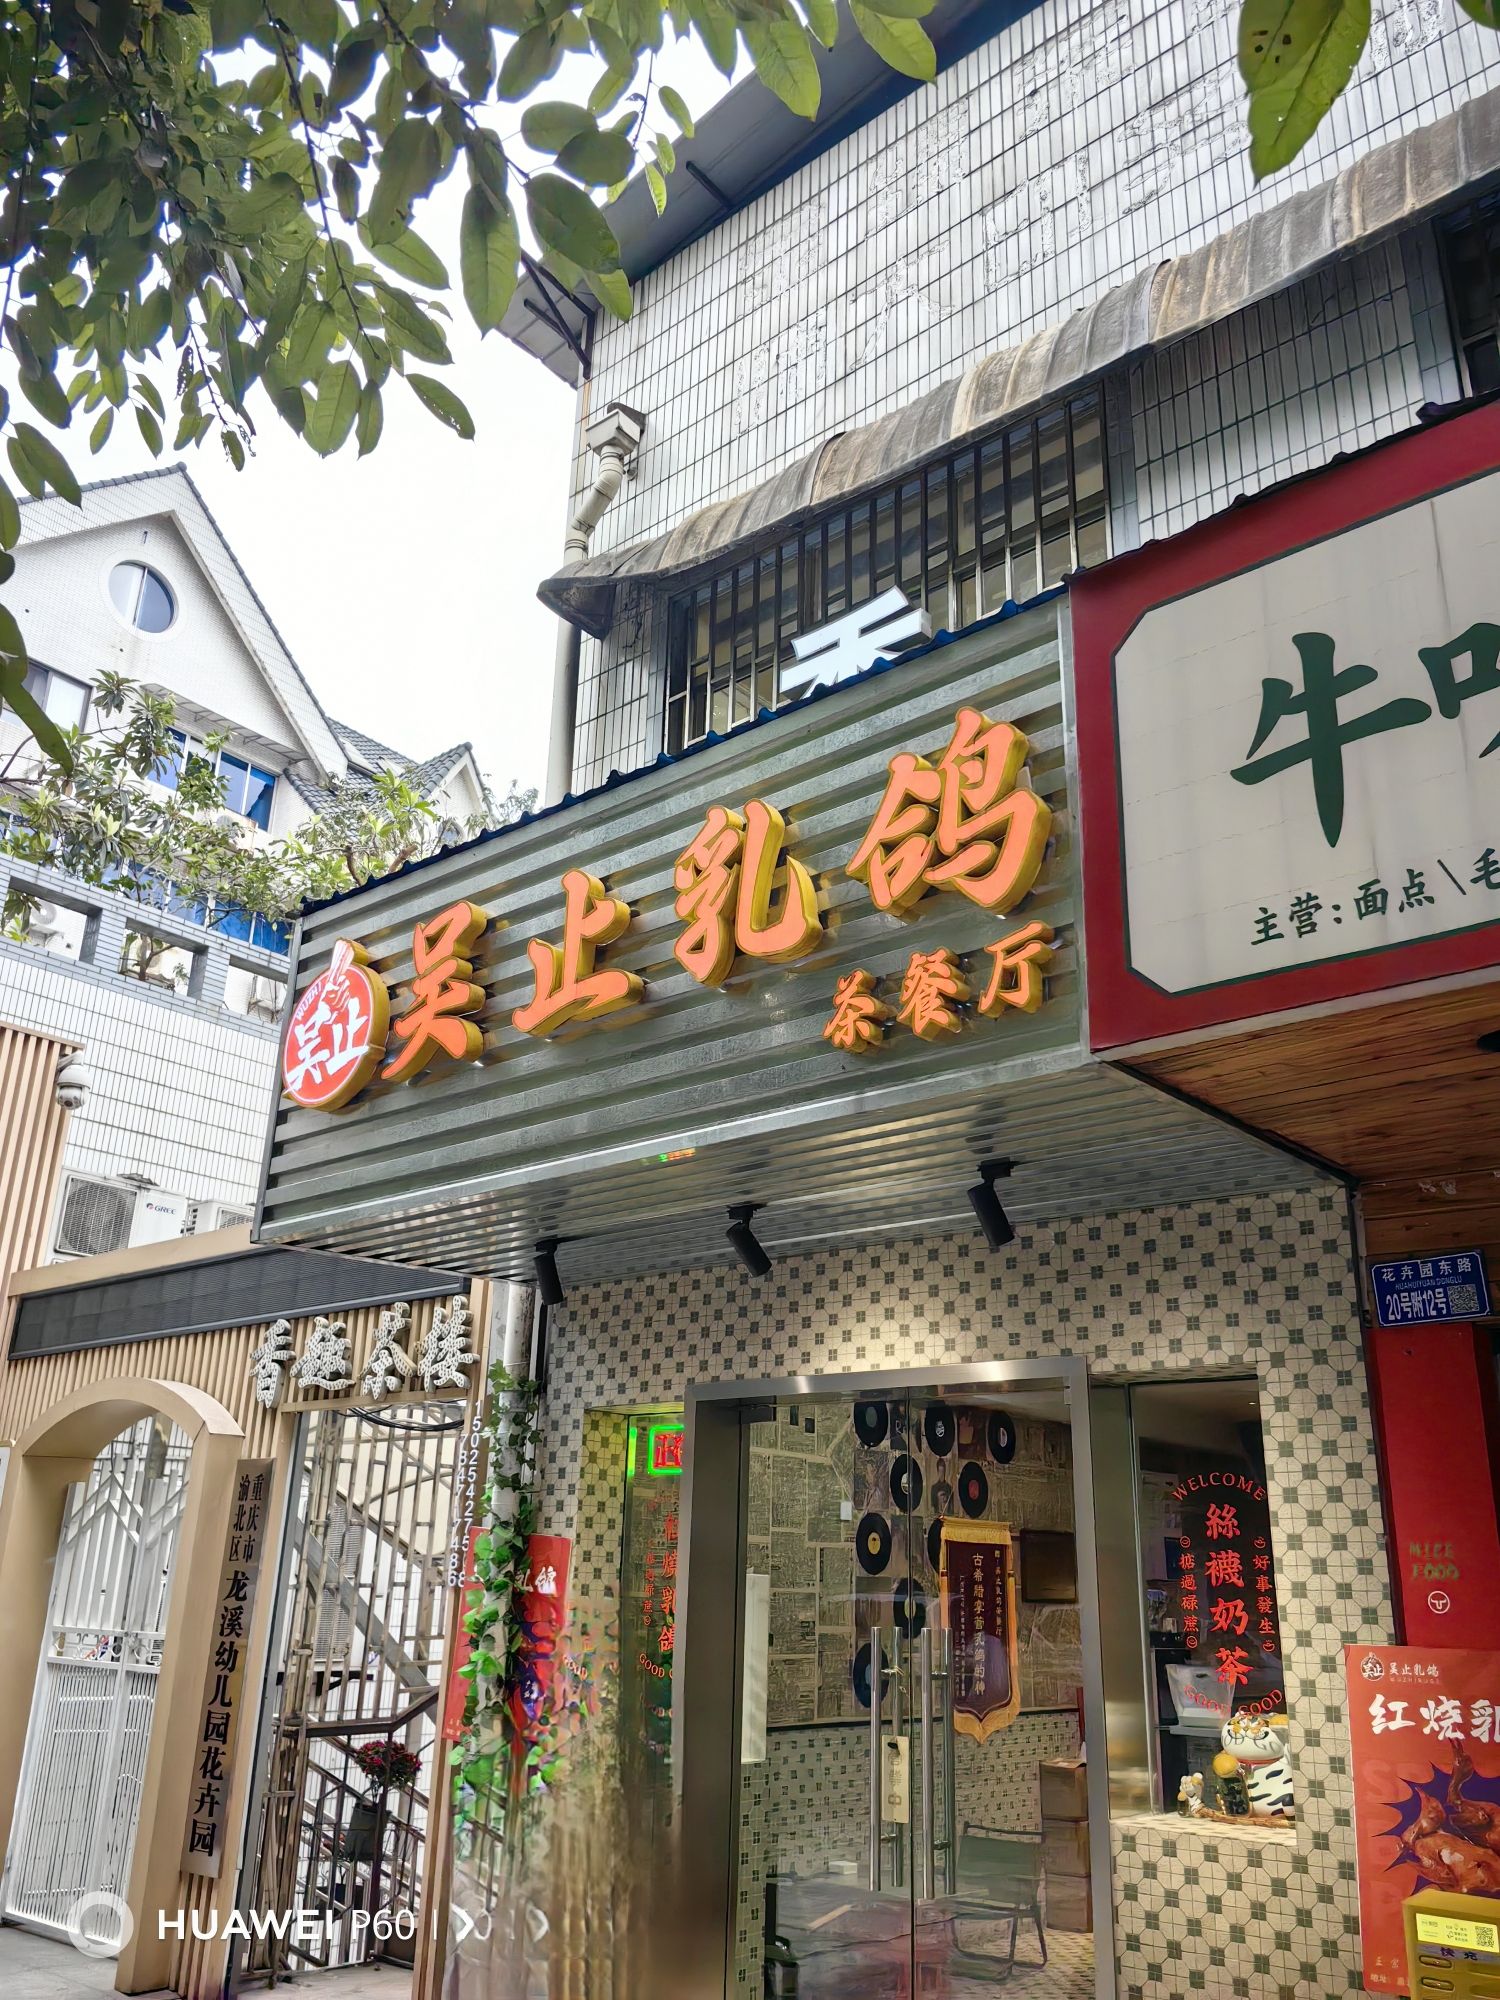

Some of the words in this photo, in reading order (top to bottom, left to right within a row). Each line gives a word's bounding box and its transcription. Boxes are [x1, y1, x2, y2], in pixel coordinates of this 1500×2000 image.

[381, 706, 1050, 1083] 吴止乳鸽
[823, 920, 1056, 1053] 茶餐厅
[1381, 1257, 1472, 1283] 花卉园东路
[1386, 1288, 1447, 1320] 20号附12号
[229, 1475, 251, 1562] 渝北区
[242, 1473, 265, 1563] 重庆市
[457, 1400, 483, 1588] 1502542758
[1171, 1471, 1267, 1503] WELCOME
[1204, 1502, 1254, 1687] 絲襪奶茶
[1252, 1554, 1276, 1635] 好事發生
[639, 1653, 665, 1678] GOOD
[1238, 1688, 1283, 1716] GOOD
[1389, 1662, 1440, 1679] 吴止乳鸽
[188, 1569, 249, 1858] 龙溪幼儿园花卉园
